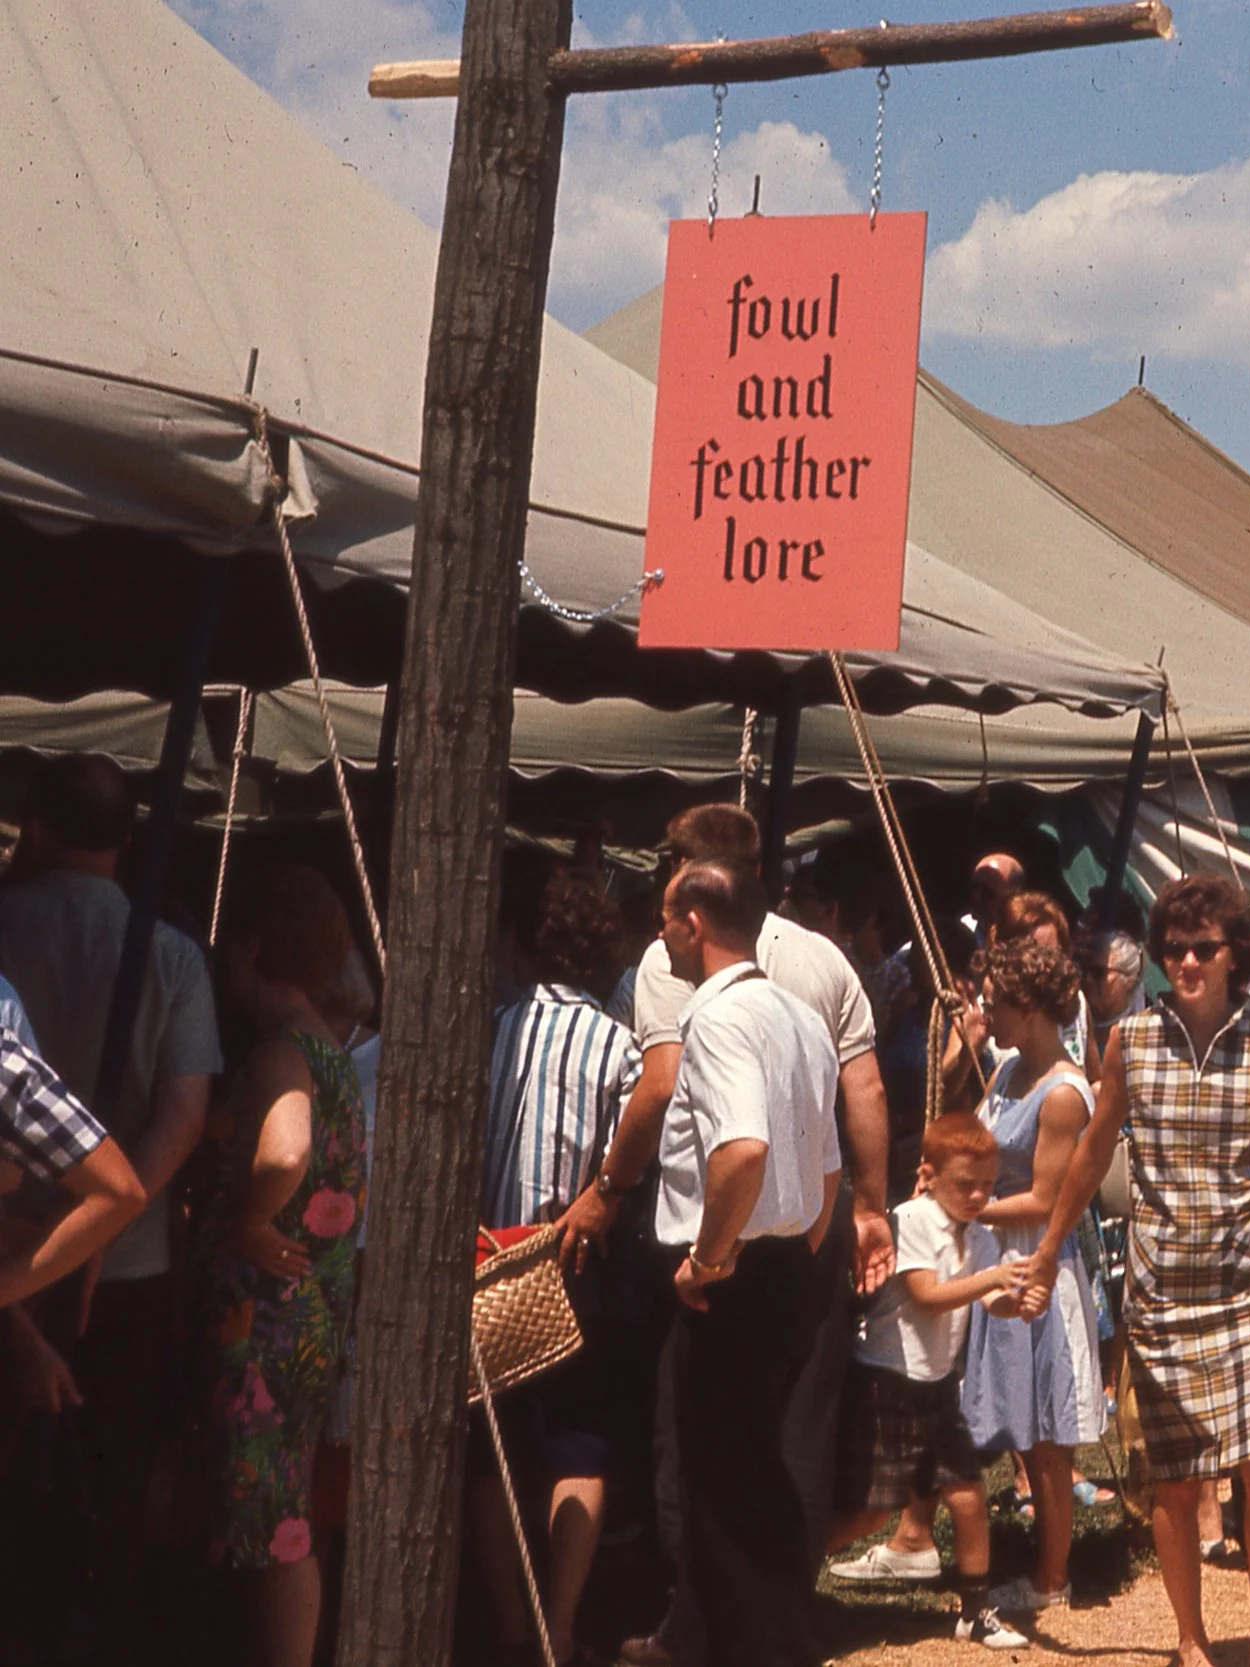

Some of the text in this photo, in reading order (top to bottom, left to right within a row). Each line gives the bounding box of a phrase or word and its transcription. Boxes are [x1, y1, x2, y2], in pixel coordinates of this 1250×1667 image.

[727, 273, 839, 358] fowl
[738, 354, 834, 420] and
[690, 435, 871, 520] feather
[723, 516, 826, 583] lore
